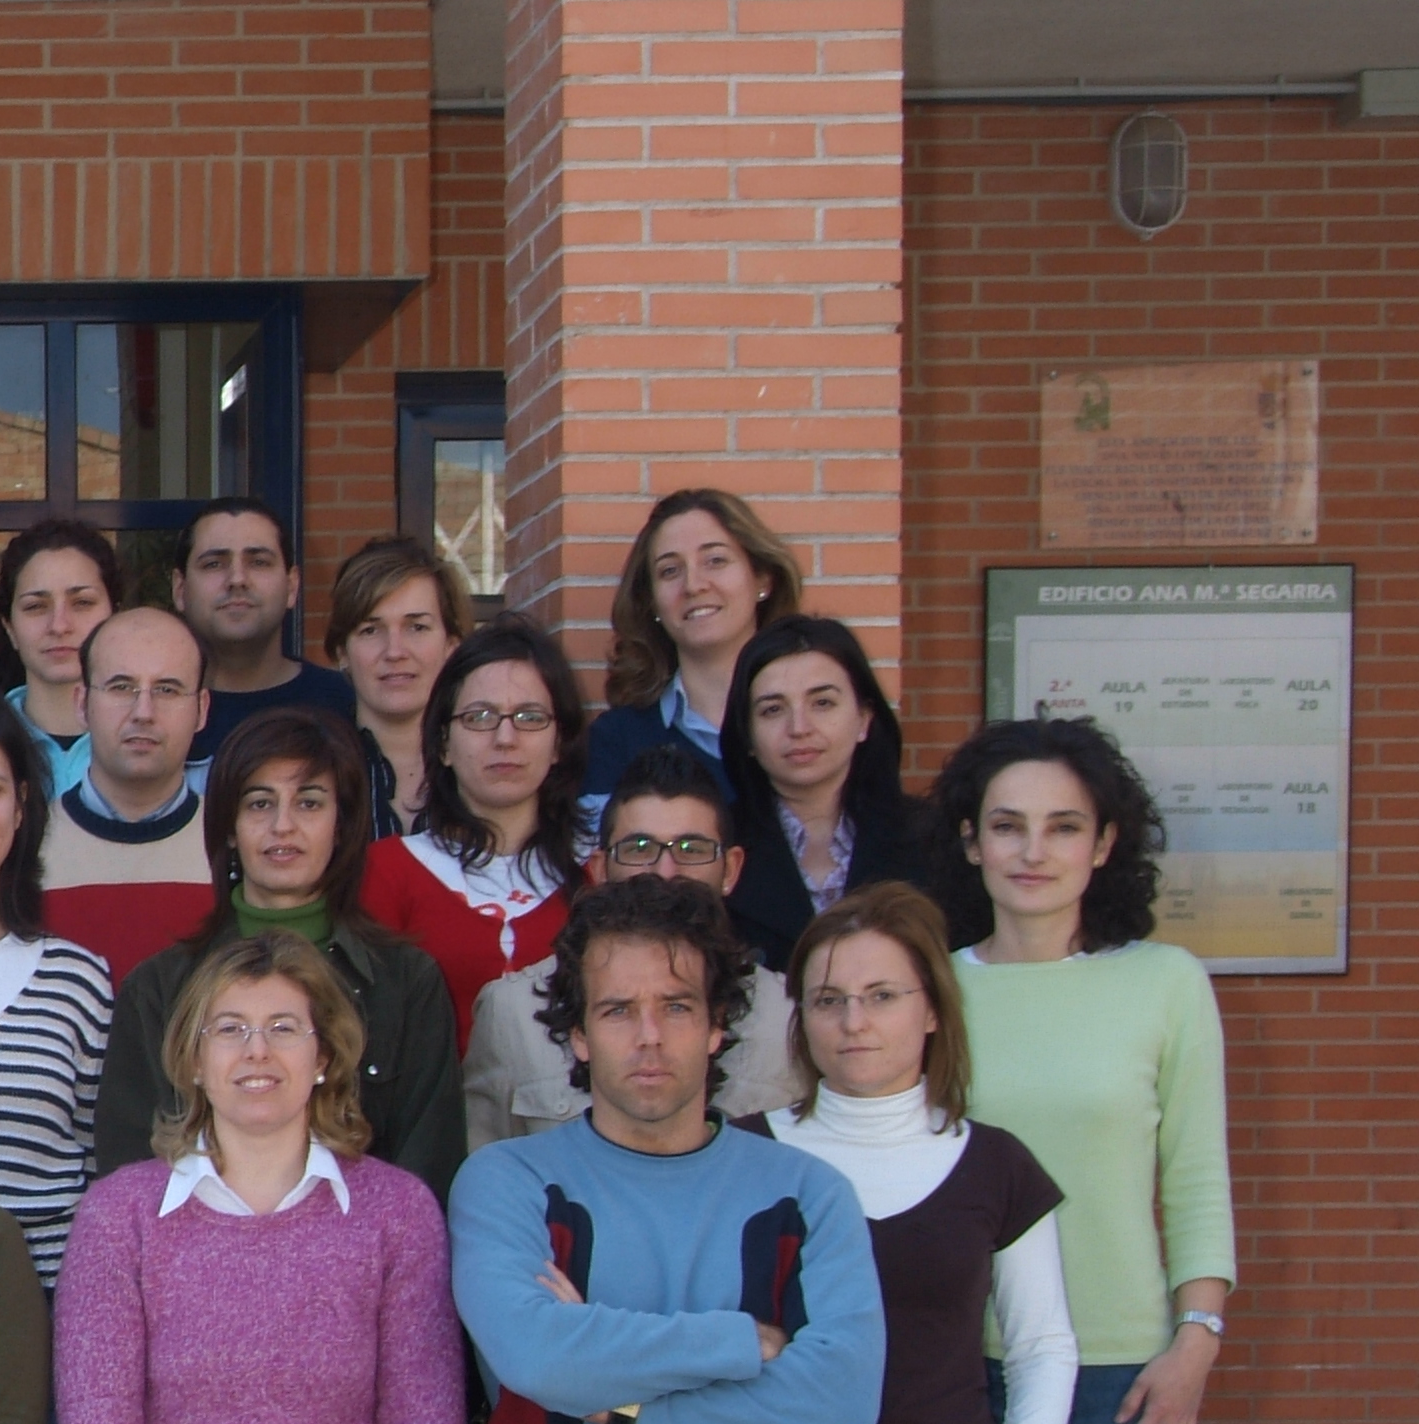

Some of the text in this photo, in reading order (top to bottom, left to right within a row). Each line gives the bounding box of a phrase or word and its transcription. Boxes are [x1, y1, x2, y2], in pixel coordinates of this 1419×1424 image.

[1038, 585, 1133, 602] EDIFICIO
[1139, 584, 1188, 601] ANA
[1235, 583, 1337, 600] SEGARRA
[1101, 681, 1147, 693] AULA
[1286, 679, 1331, 692] AULA
[1115, 701, 1133, 713] 19
[1298, 699, 1319, 711] 20
[1283, 781, 1329, 795] AULA
